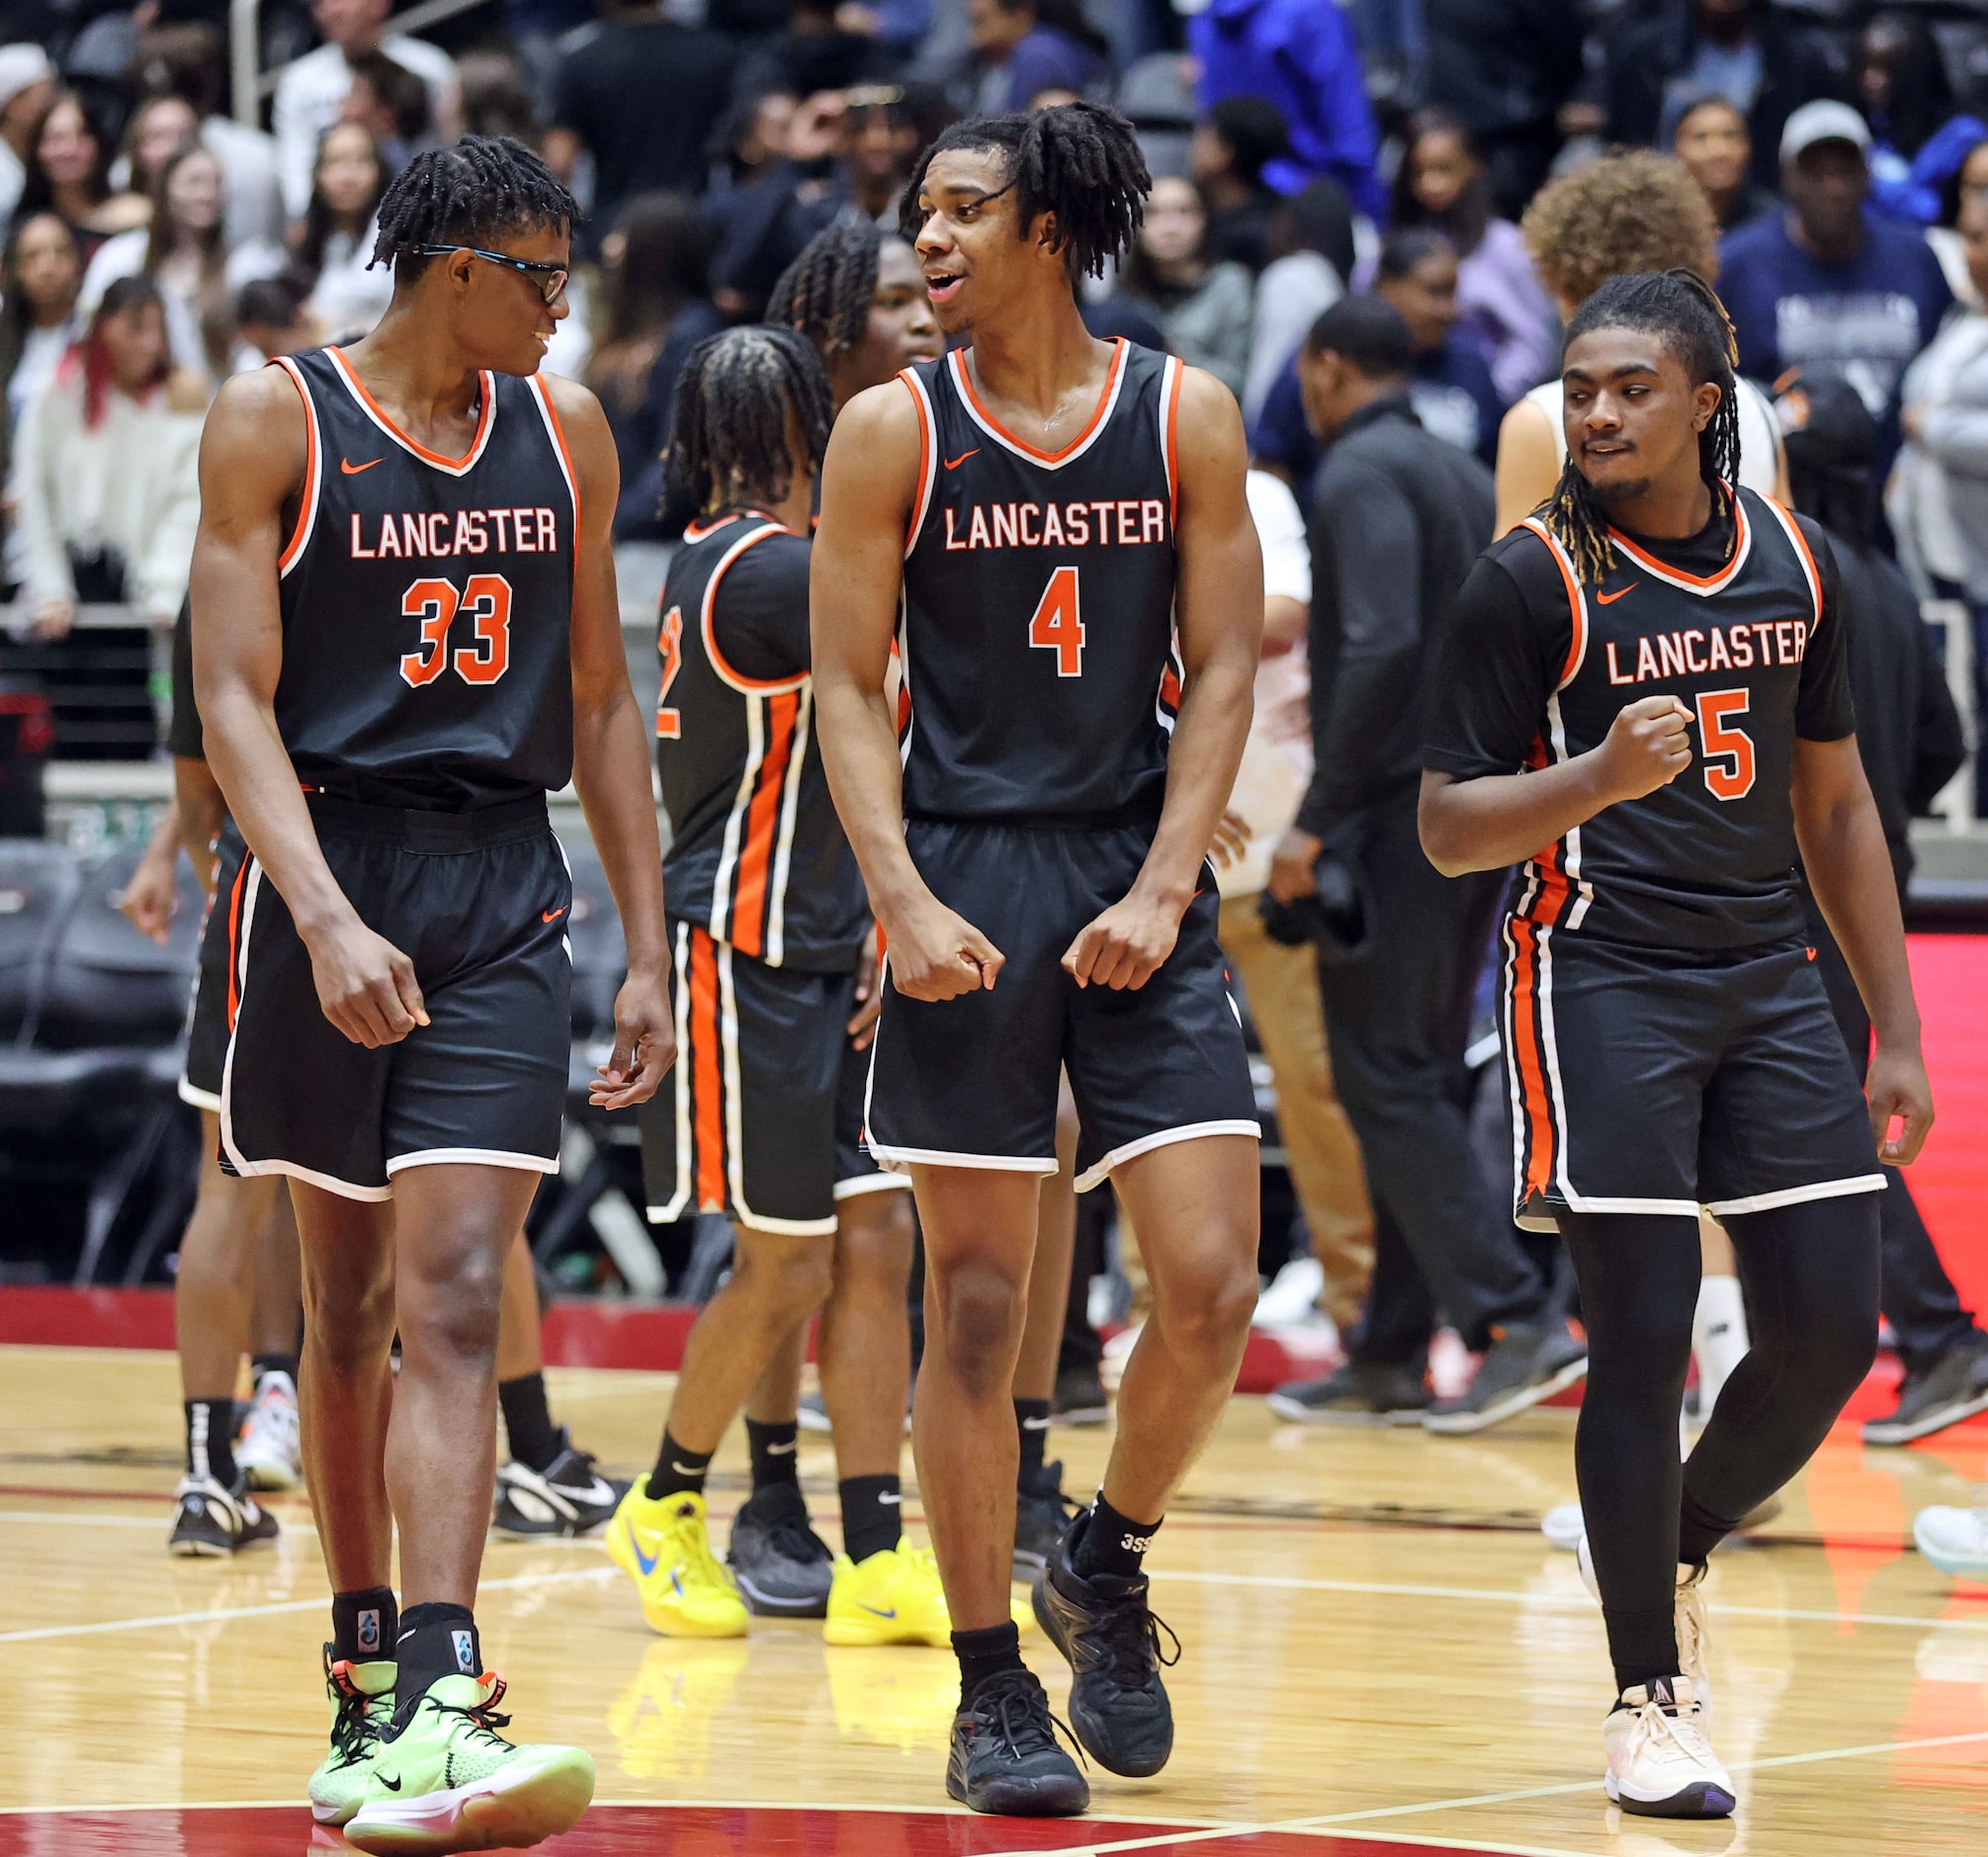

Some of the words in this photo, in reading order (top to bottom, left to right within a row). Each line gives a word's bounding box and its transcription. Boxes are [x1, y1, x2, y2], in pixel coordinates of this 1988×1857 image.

[350, 505, 558, 559] LANCASTER
[943, 499, 1165, 551] LANCASTER
[398, 573, 513, 689] 33
[1028, 565, 1086, 678] 4
[1605, 619, 1807, 685] LANCASTER
[1694, 686, 1757, 802] 5
